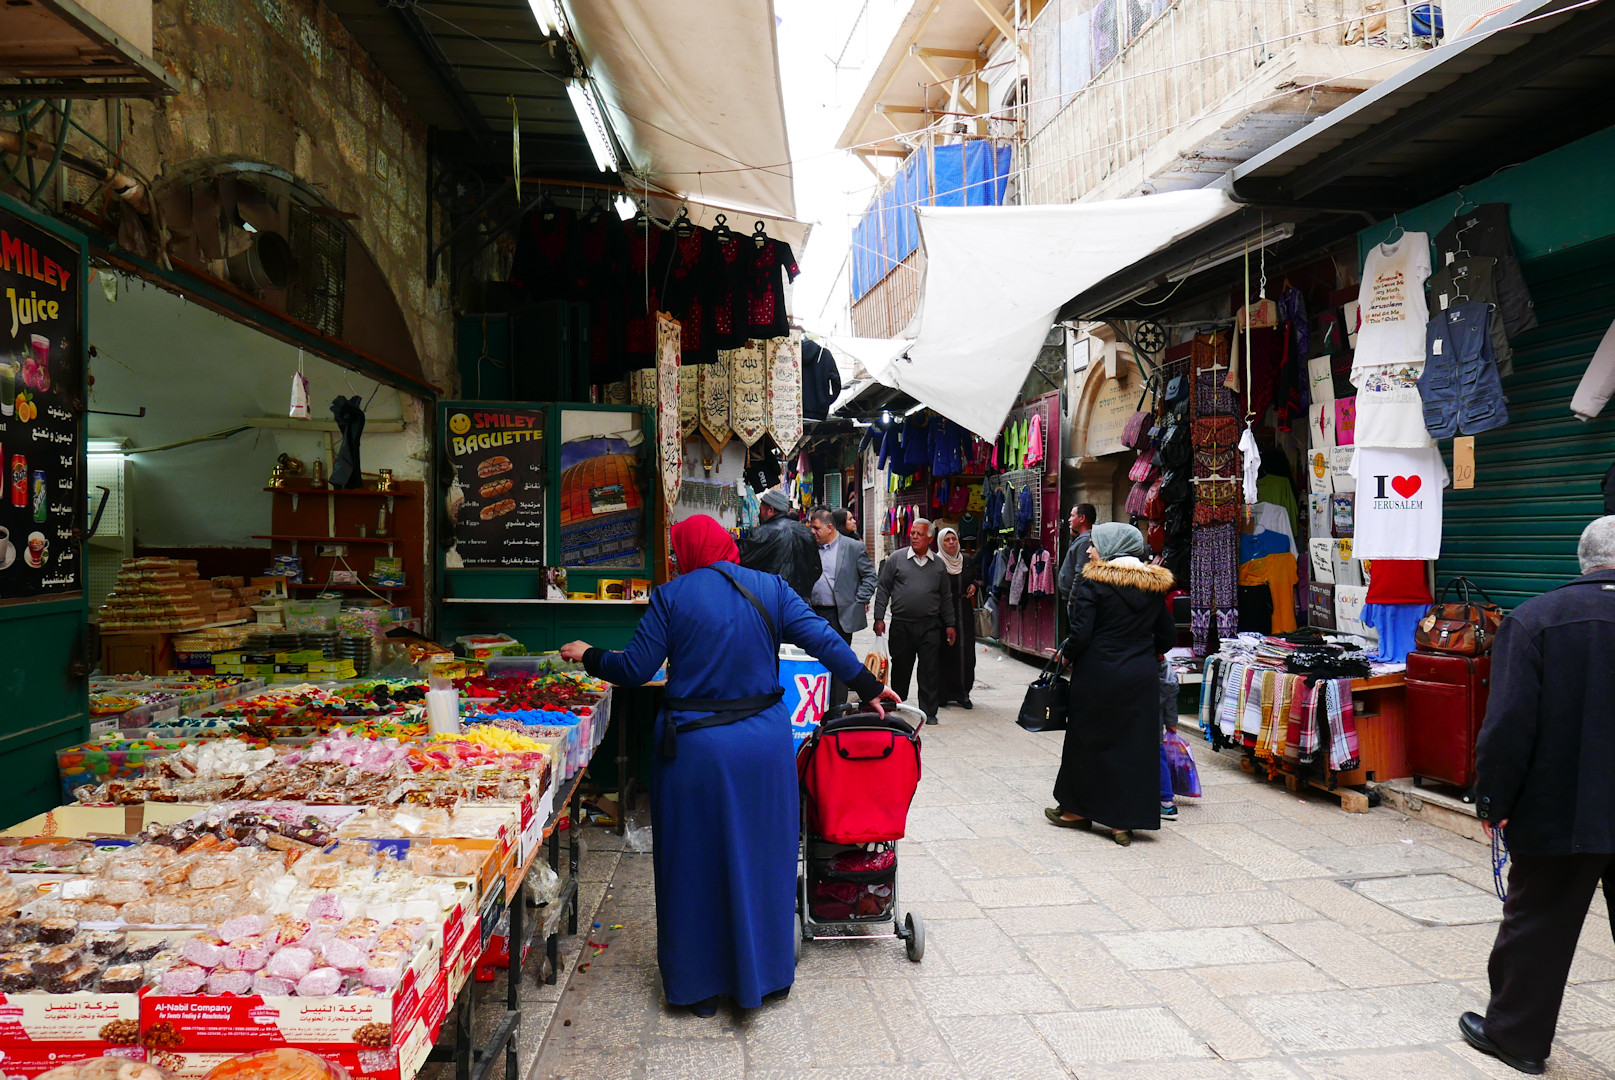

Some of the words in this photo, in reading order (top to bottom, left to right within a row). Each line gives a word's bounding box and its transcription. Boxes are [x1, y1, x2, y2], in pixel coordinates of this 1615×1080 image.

[0, 230, 71, 291] MILEY
[6, 288, 59, 339] Juice
[474, 413, 536, 429] SMILEY
[452, 430, 543, 457] BAGUETTE
[1456, 464, 1472, 483] 20
[1373, 475, 1389, 499] I
[1373, 500, 1423, 510] JERUSALEM
[57, 547, 73, 567] شاي
[45, 1002, 82, 1013] النبيل
[84, 1001, 120, 1012] شركة
[155, 1003, 189, 1011] Al-Nabil
[190, 1004, 232, 1013] Company
[300, 1005, 337, 1015] النبيل
[339, 1004, 373, 1014] شركة
